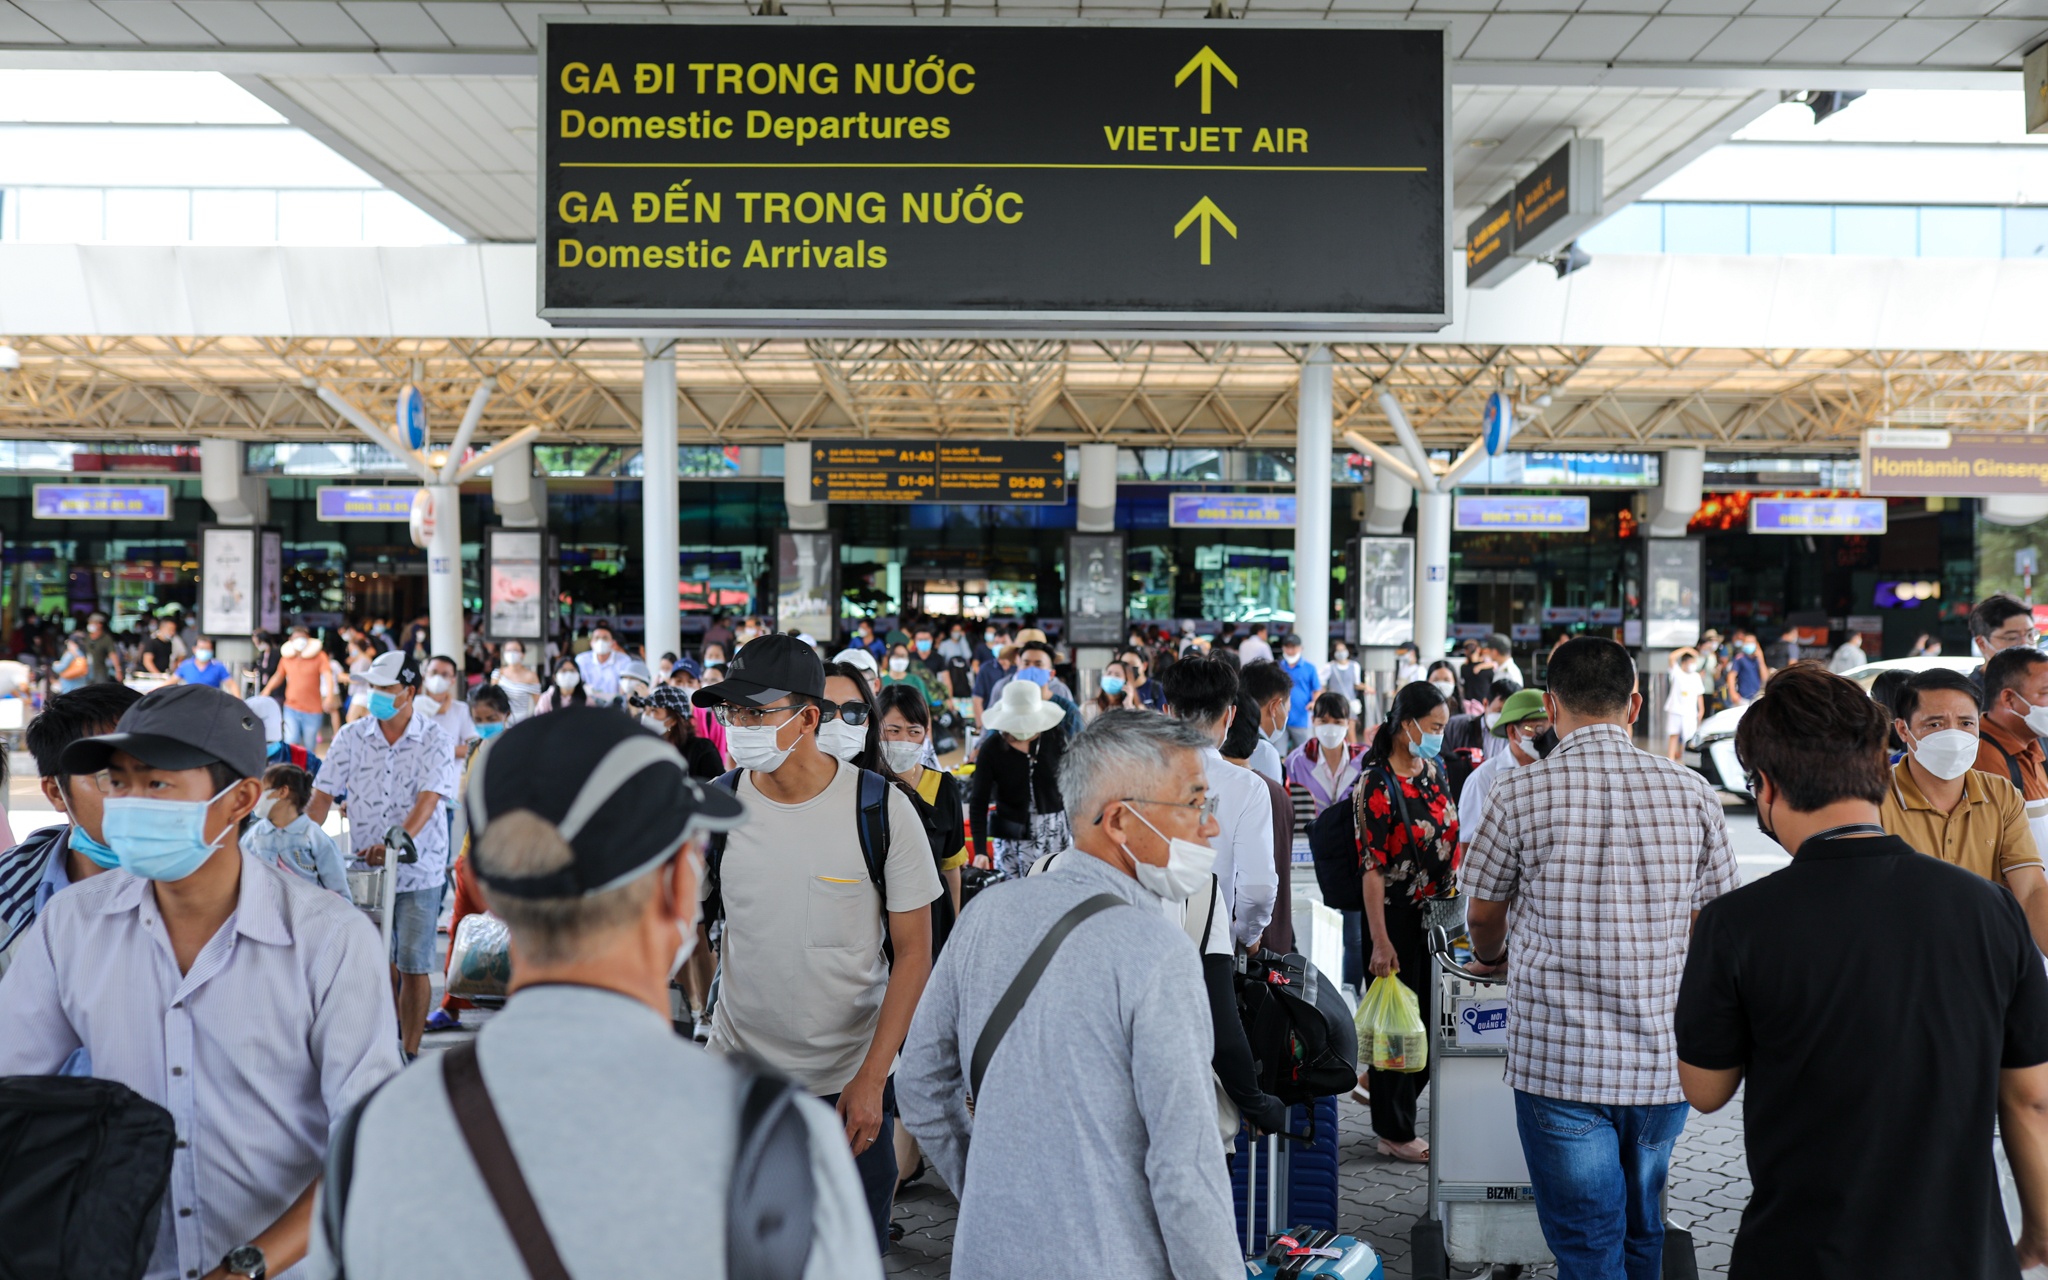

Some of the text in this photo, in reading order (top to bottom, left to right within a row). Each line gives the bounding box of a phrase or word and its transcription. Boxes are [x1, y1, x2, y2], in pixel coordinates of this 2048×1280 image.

[560, 54, 976, 95] GA ĐI TRONG NƯỚC
[560, 109, 951, 147] Domestic Departures
[1104, 125, 1309, 153] VIETJET AIR
[558, 178, 1024, 225] GA ĐẾN TRONG NƯỚC
[558, 238, 887, 269] Domestic Arrivals
[899, 450, 936, 463] A1-A3
[1872, 456, 2048, 482] Homtamin Ginseng
[898, 475, 935, 488] D1-D4
